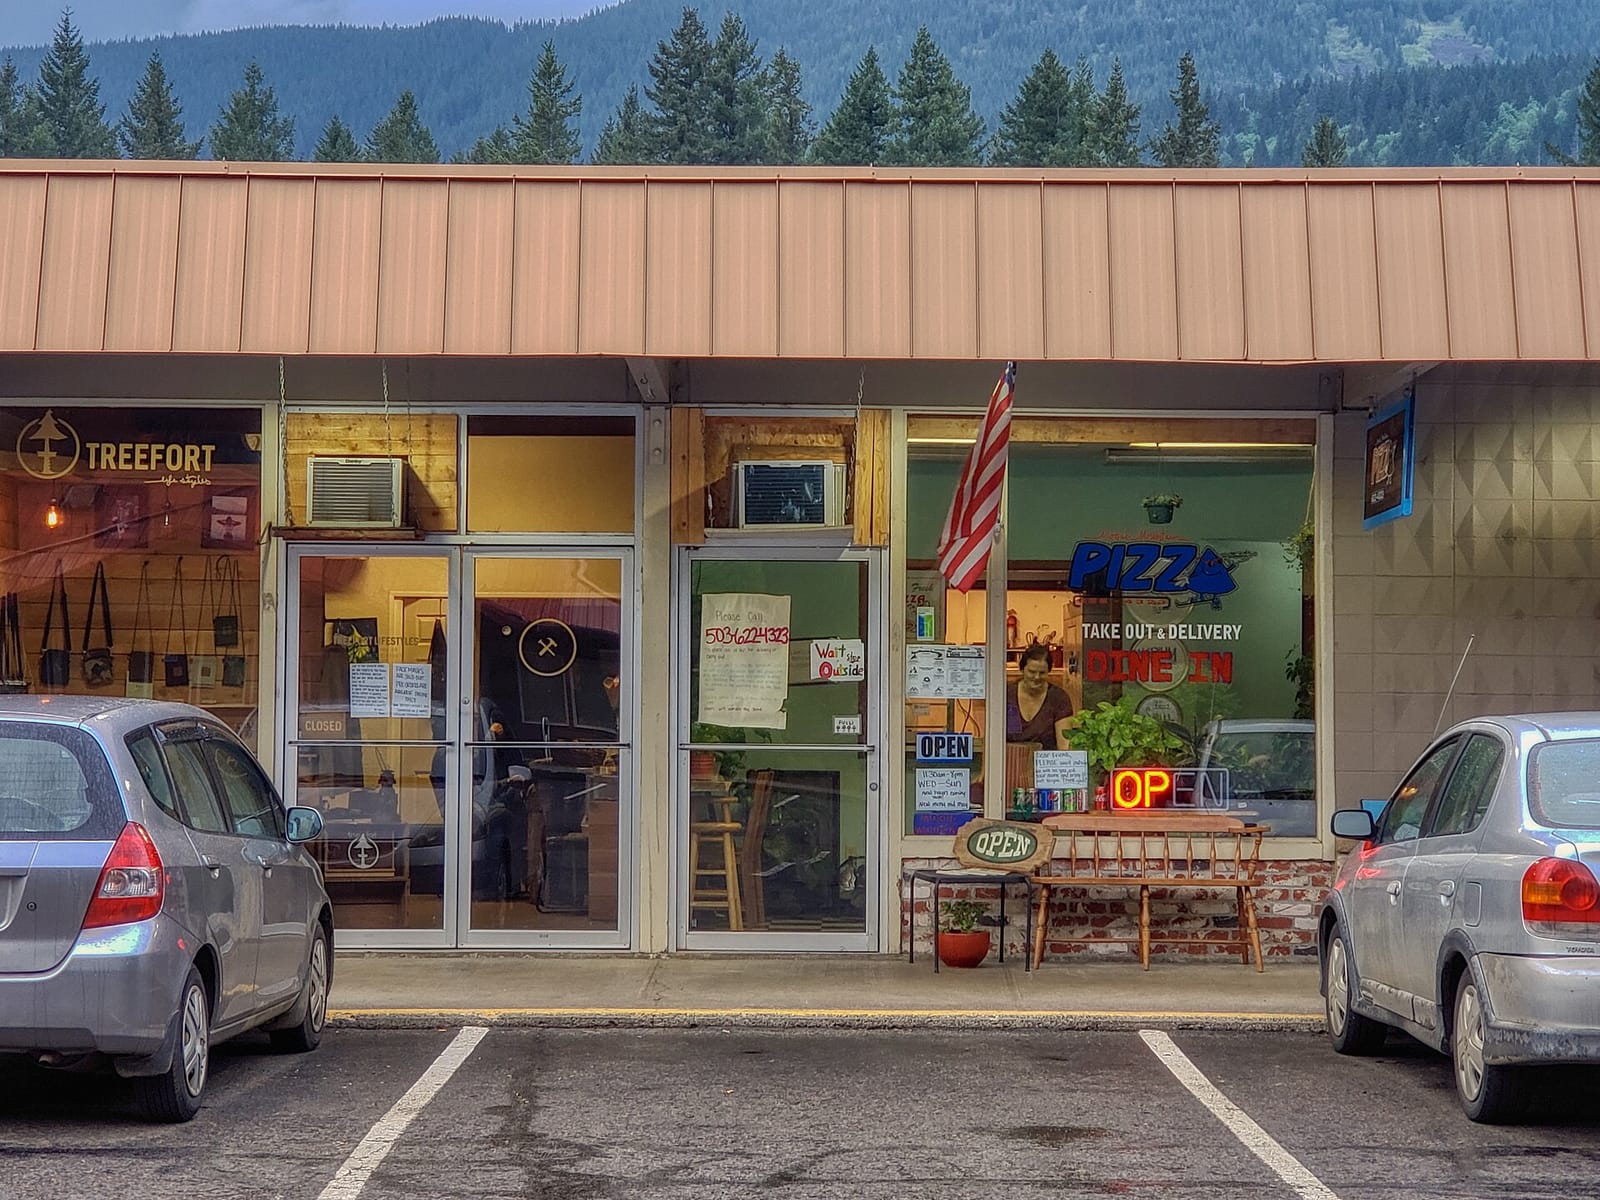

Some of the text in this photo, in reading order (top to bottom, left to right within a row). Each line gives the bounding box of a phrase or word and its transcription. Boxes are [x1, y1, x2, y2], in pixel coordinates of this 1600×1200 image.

[86, 442, 215, 471] TREEFORT
[715, 609, 741, 622] Please
[1082, 623, 1242, 640] TAKE OUT & DELIVERY
[814, 643, 847, 659] Wait
[819, 661, 864, 679] Outside
[1086, 650, 1173, 683] DINE
[1187, 652, 1234, 684] IN
[305, 720, 342, 732] CLOSED
[920, 735, 969, 758] OPEN
[1115, 770, 1222, 808] OPEN
[976, 833, 1031, 858] OPEN
